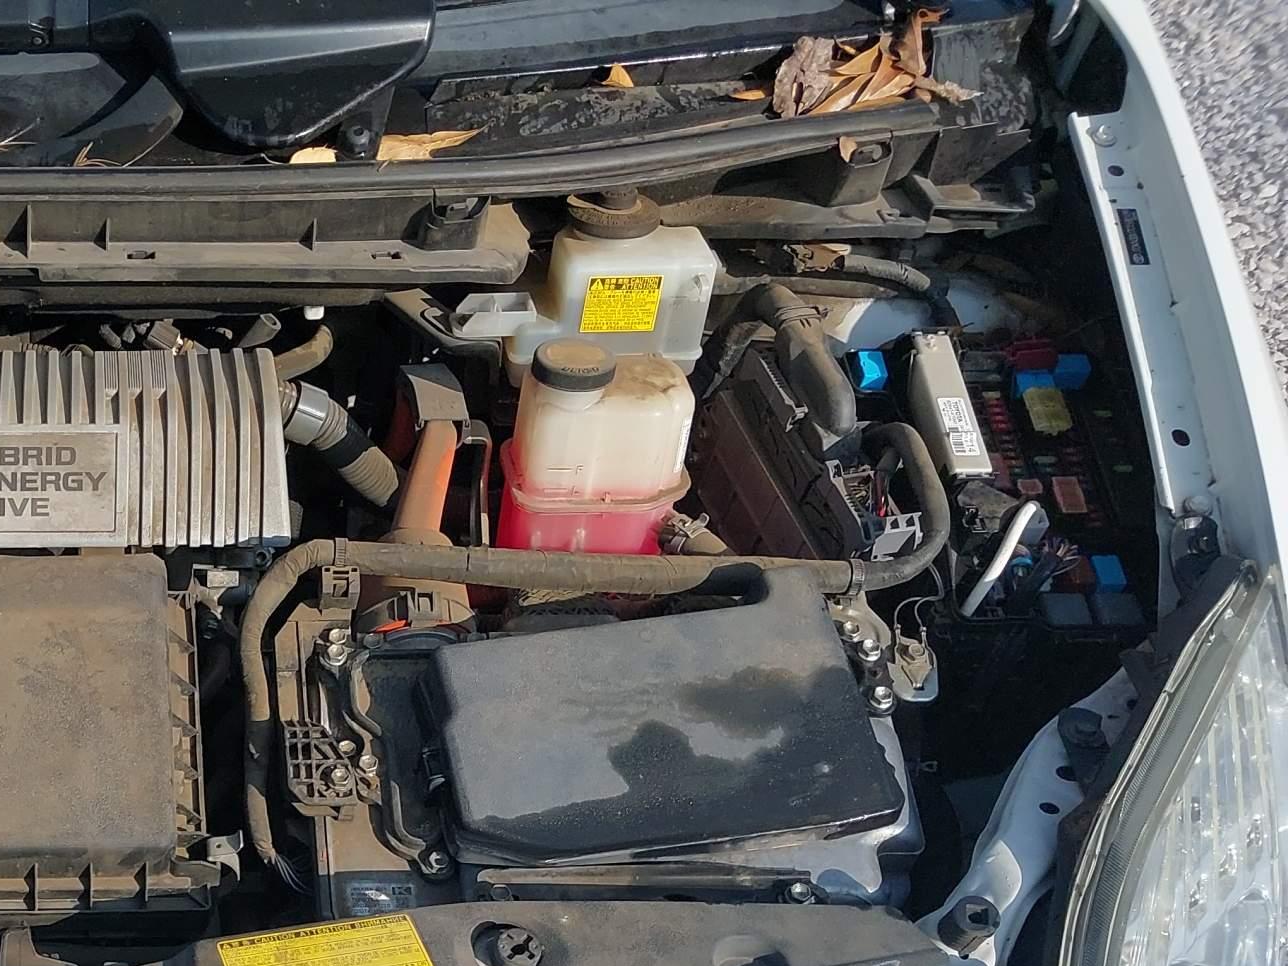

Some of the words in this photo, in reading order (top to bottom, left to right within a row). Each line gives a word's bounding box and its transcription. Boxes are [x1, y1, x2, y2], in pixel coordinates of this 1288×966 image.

[631, 276, 659, 284] CAUTION
[254, 932, 296, 945] CAUTION
[299, 922, 350, 938] ATTENTION
